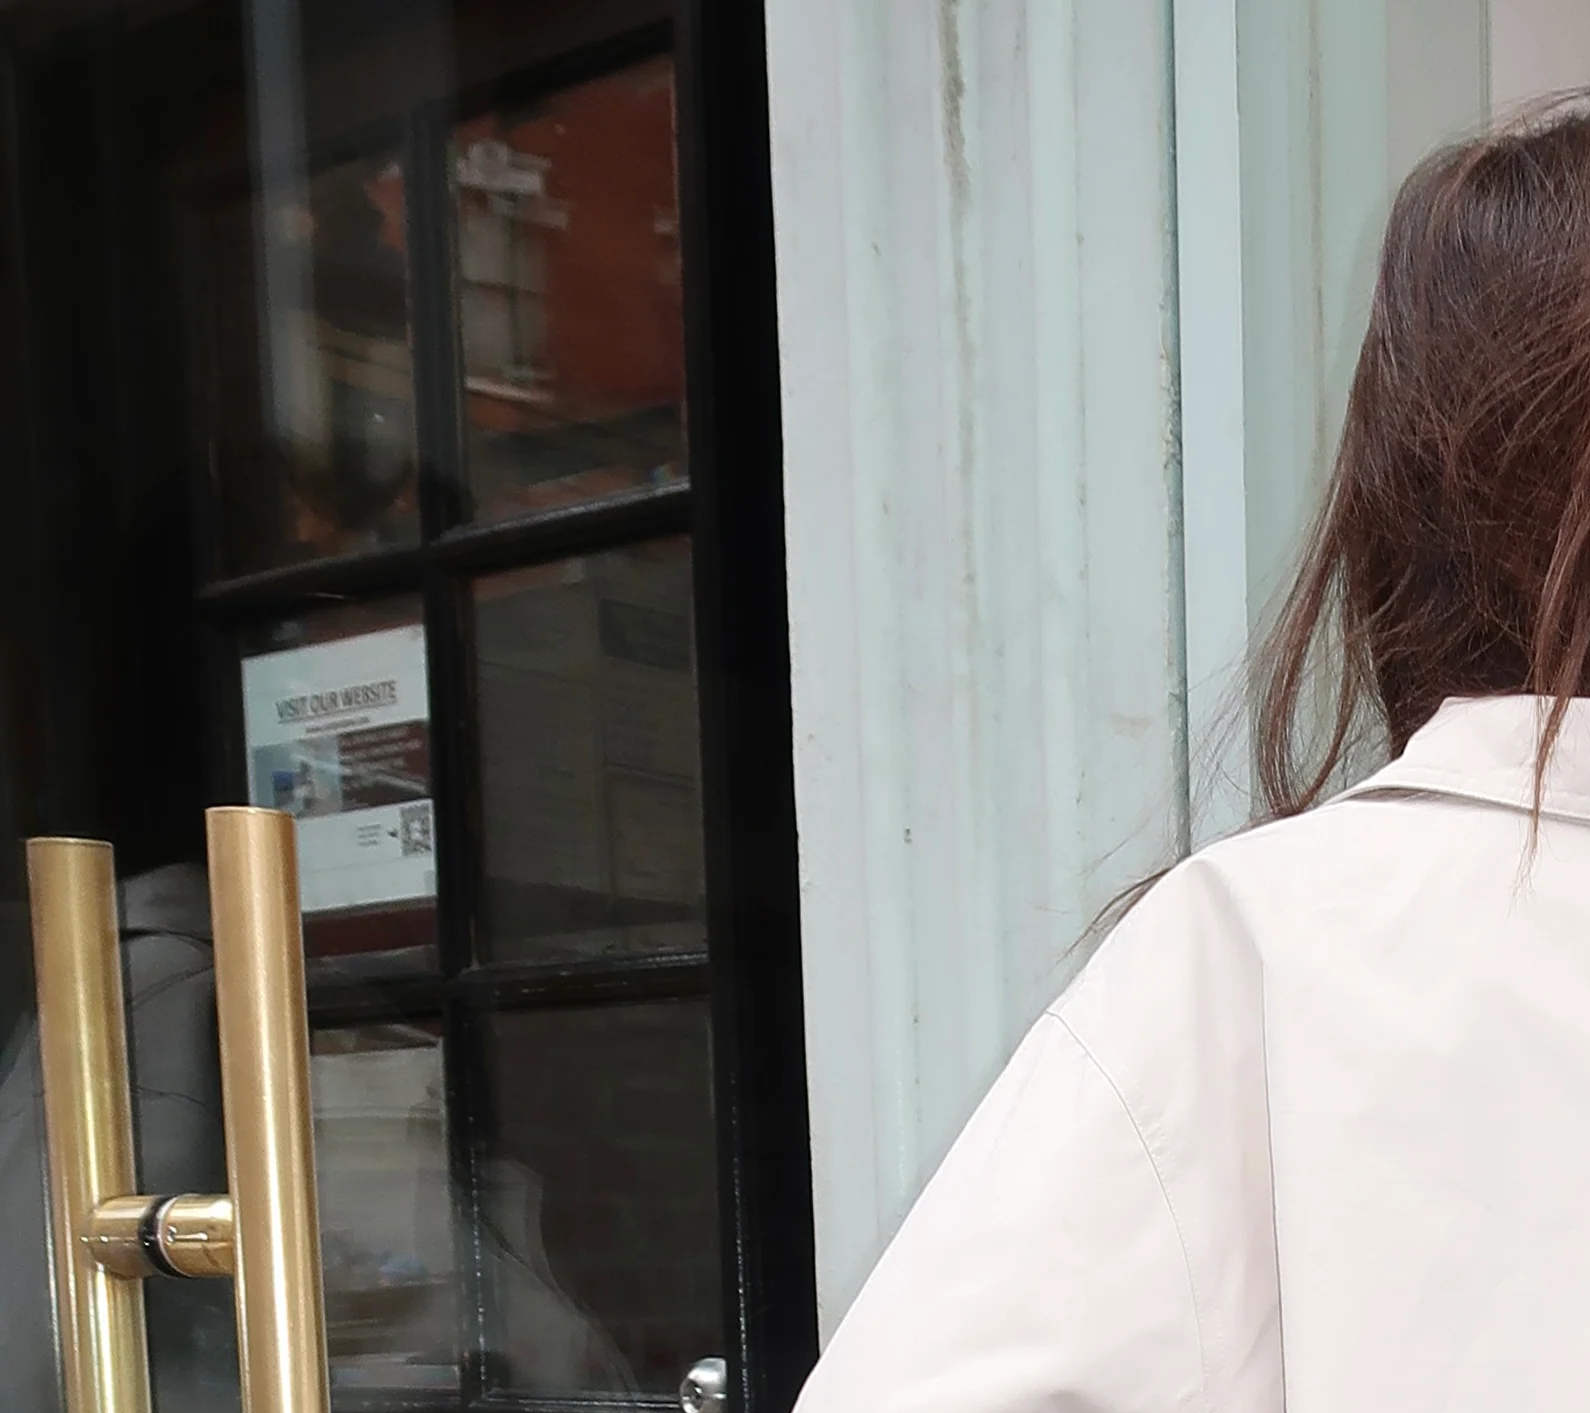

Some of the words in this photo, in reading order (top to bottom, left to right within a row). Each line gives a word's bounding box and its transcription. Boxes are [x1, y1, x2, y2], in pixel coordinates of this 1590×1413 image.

[275, 695, 307, 719] VISIT
[309, 690, 338, 714] OUR
[340, 679, 397, 708] WEBSITE
